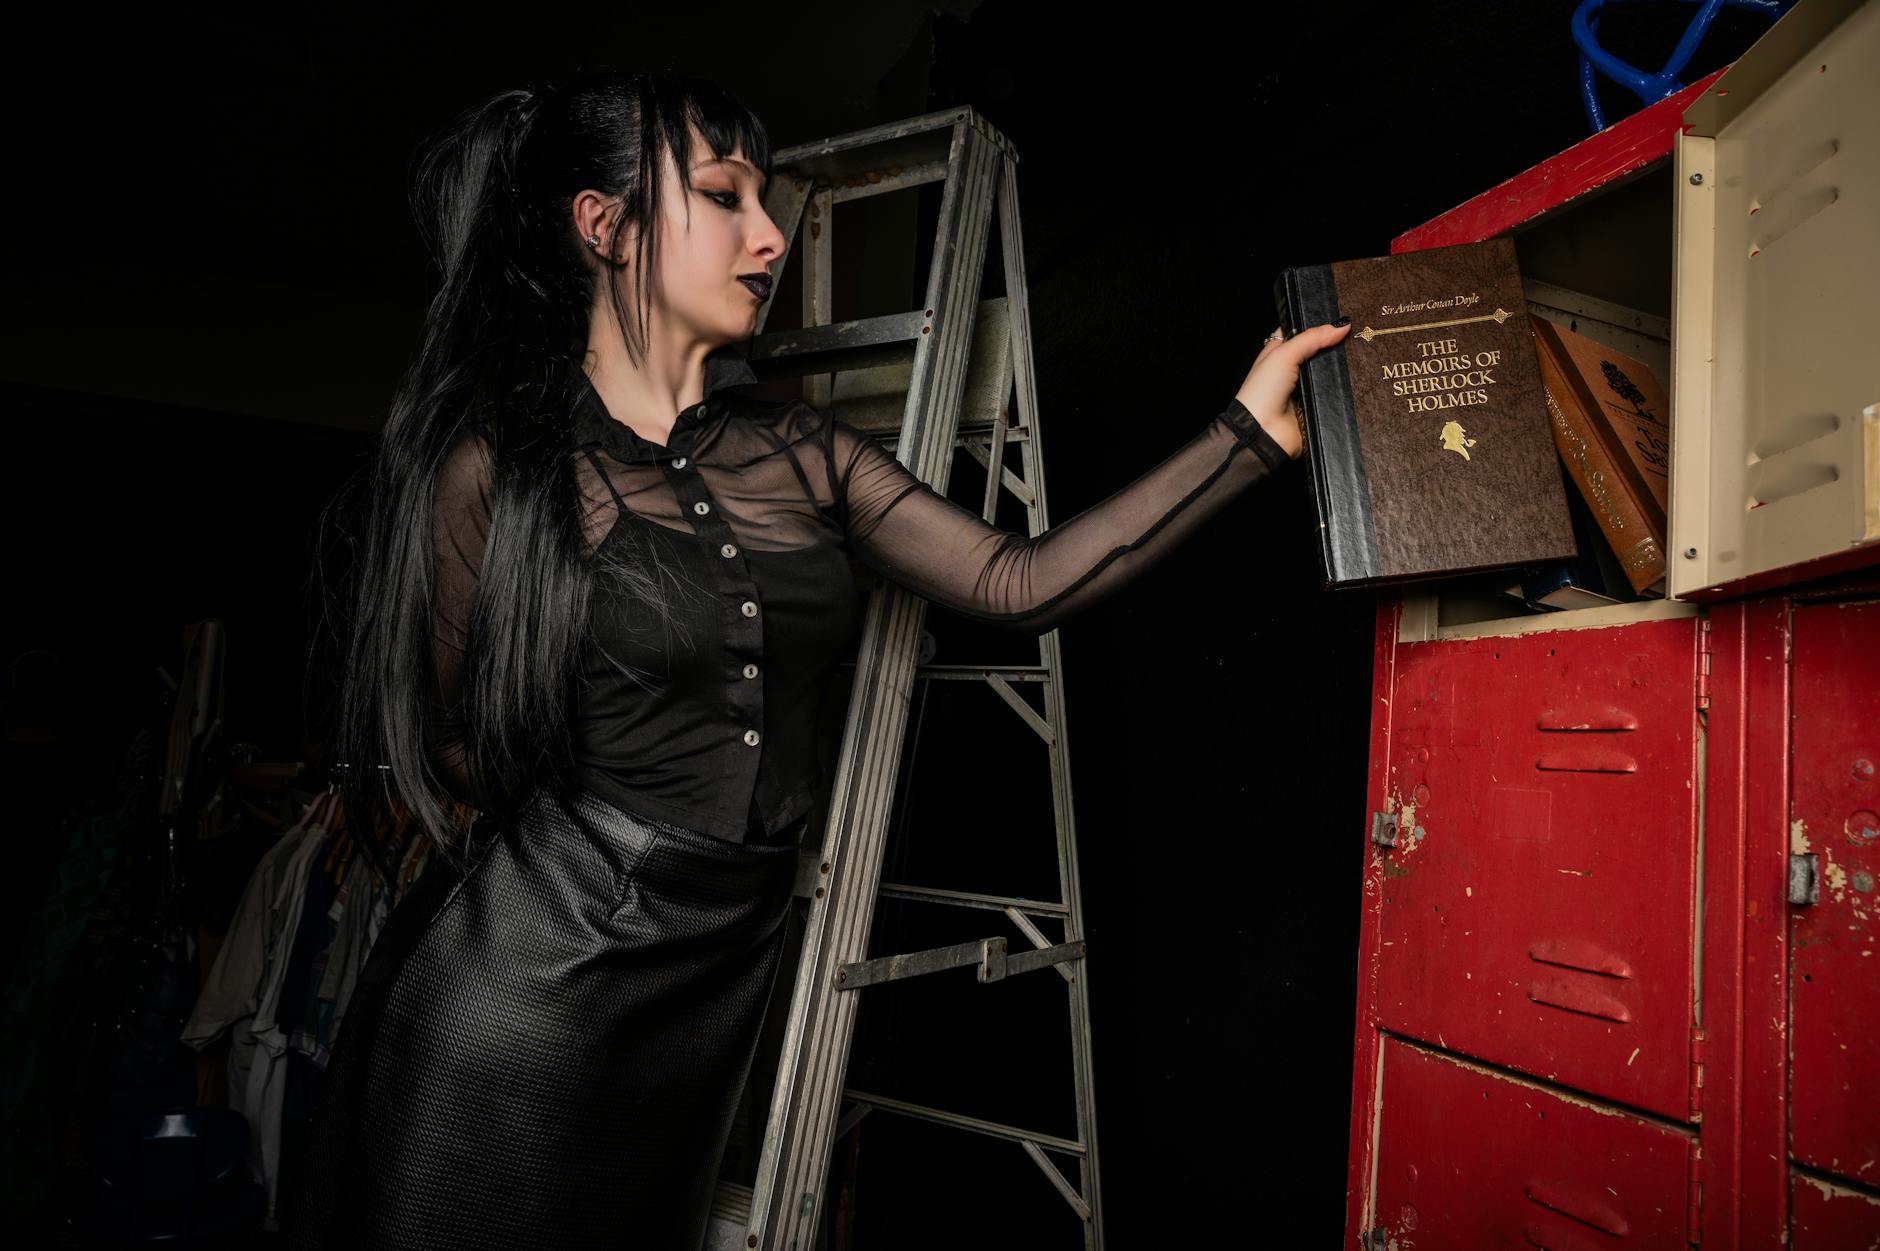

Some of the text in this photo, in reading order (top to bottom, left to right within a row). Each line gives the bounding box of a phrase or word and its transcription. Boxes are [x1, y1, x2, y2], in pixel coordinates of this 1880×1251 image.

[1381, 293, 1479, 316] Sir Arthur Conan Doyle
[1417, 339, 1458, 357] THE
[1381, 350, 1501, 379] MEMOIRS OF
[1393, 369, 1496, 396] SHERLOCK
[1407, 389, 1488, 413] HOLMES
